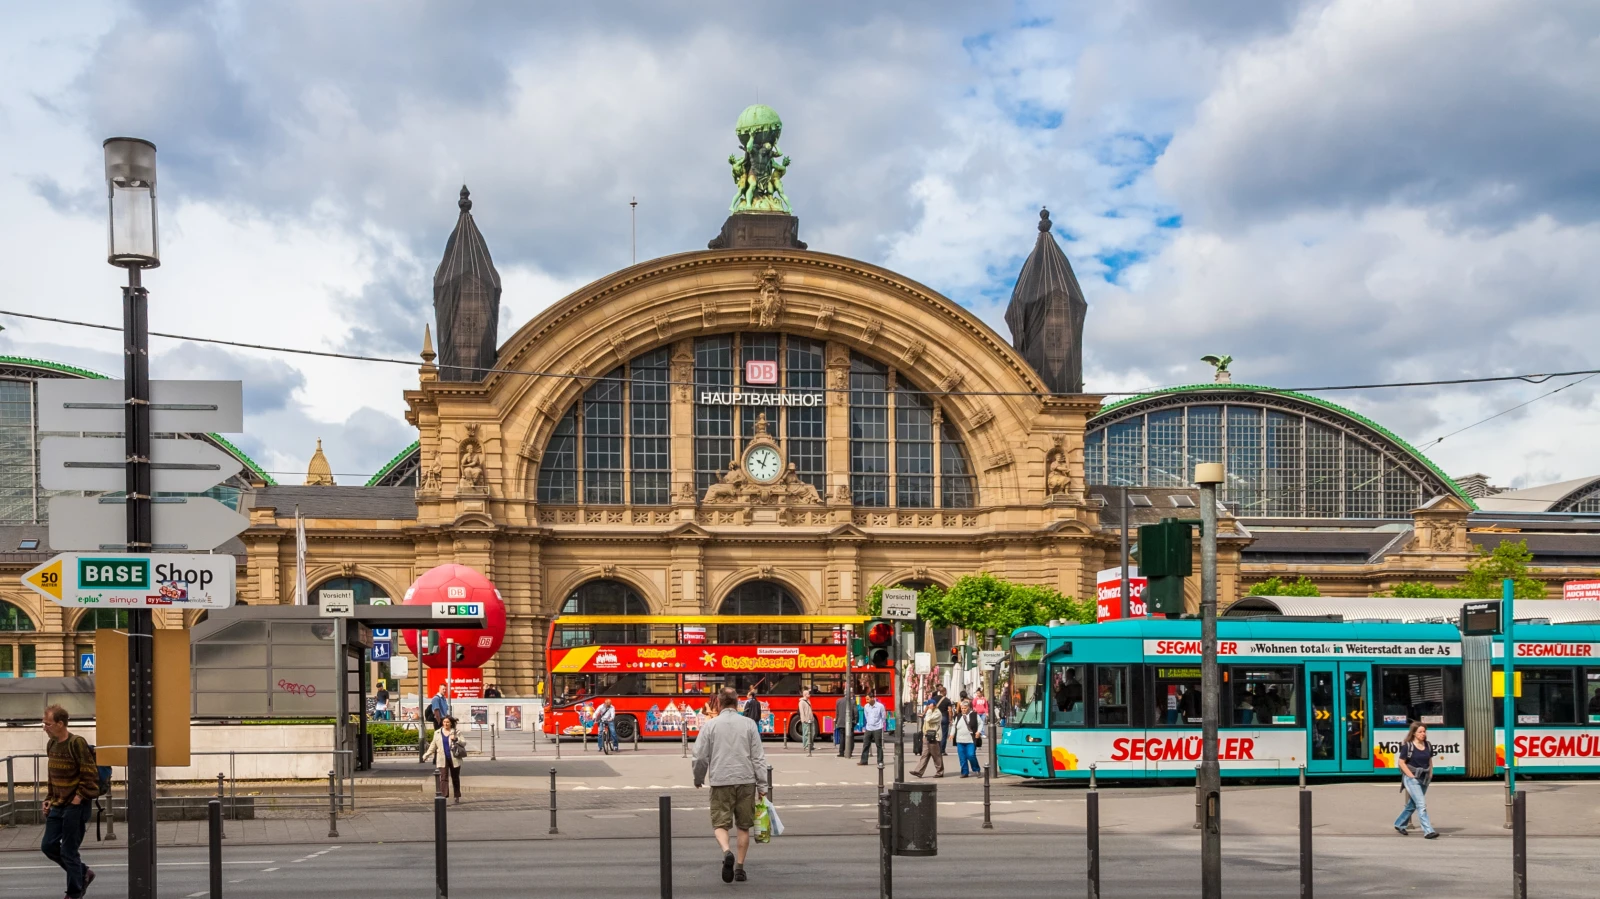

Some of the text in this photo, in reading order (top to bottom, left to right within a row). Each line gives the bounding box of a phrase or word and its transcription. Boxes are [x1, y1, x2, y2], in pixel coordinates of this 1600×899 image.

[750, 364, 774, 379] DB
[701, 391, 823, 407] HAUPTBAHNHOF
[41, 572, 58, 583] 50
[86, 562, 213, 590] BASE Shop
[109, 596, 138, 605] simyo
[459, 606, 477, 614] S U
[1098, 604, 1110, 617] Rot.
[1346, 644, 1401, 654] Weiterstadt
[1404, 646, 1416, 654] an
[1418, 645, 1434, 654] der
[1437, 645, 1450, 655] A5
[1517, 643, 1592, 656] SEGMÜLLER
[721, 655, 795, 670] CitySightseeing
[1158, 668, 1165, 678] 11
[1110, 736, 1254, 761] SEGMÜLER
